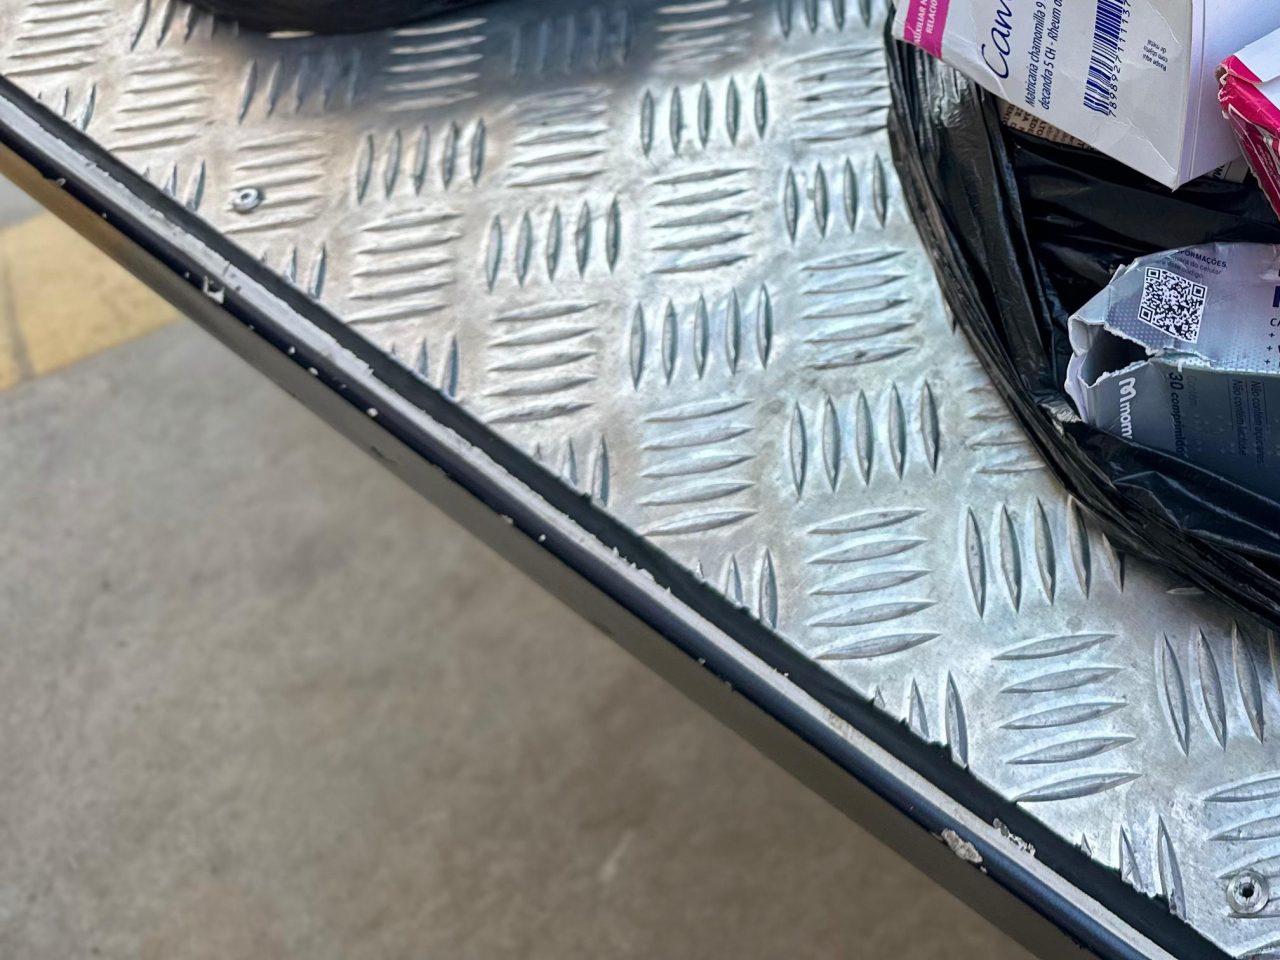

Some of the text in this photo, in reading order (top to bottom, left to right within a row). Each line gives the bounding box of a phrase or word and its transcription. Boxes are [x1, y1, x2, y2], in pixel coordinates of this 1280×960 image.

[913, 5, 926, 43] AUXILIAR
[1028, 8, 1045, 63] chamomilla
[1040, 67, 1053, 110] decandra
[1048, 6, 1060, 41] Rheum
[1023, 61, 1038, 107] Matricaria
